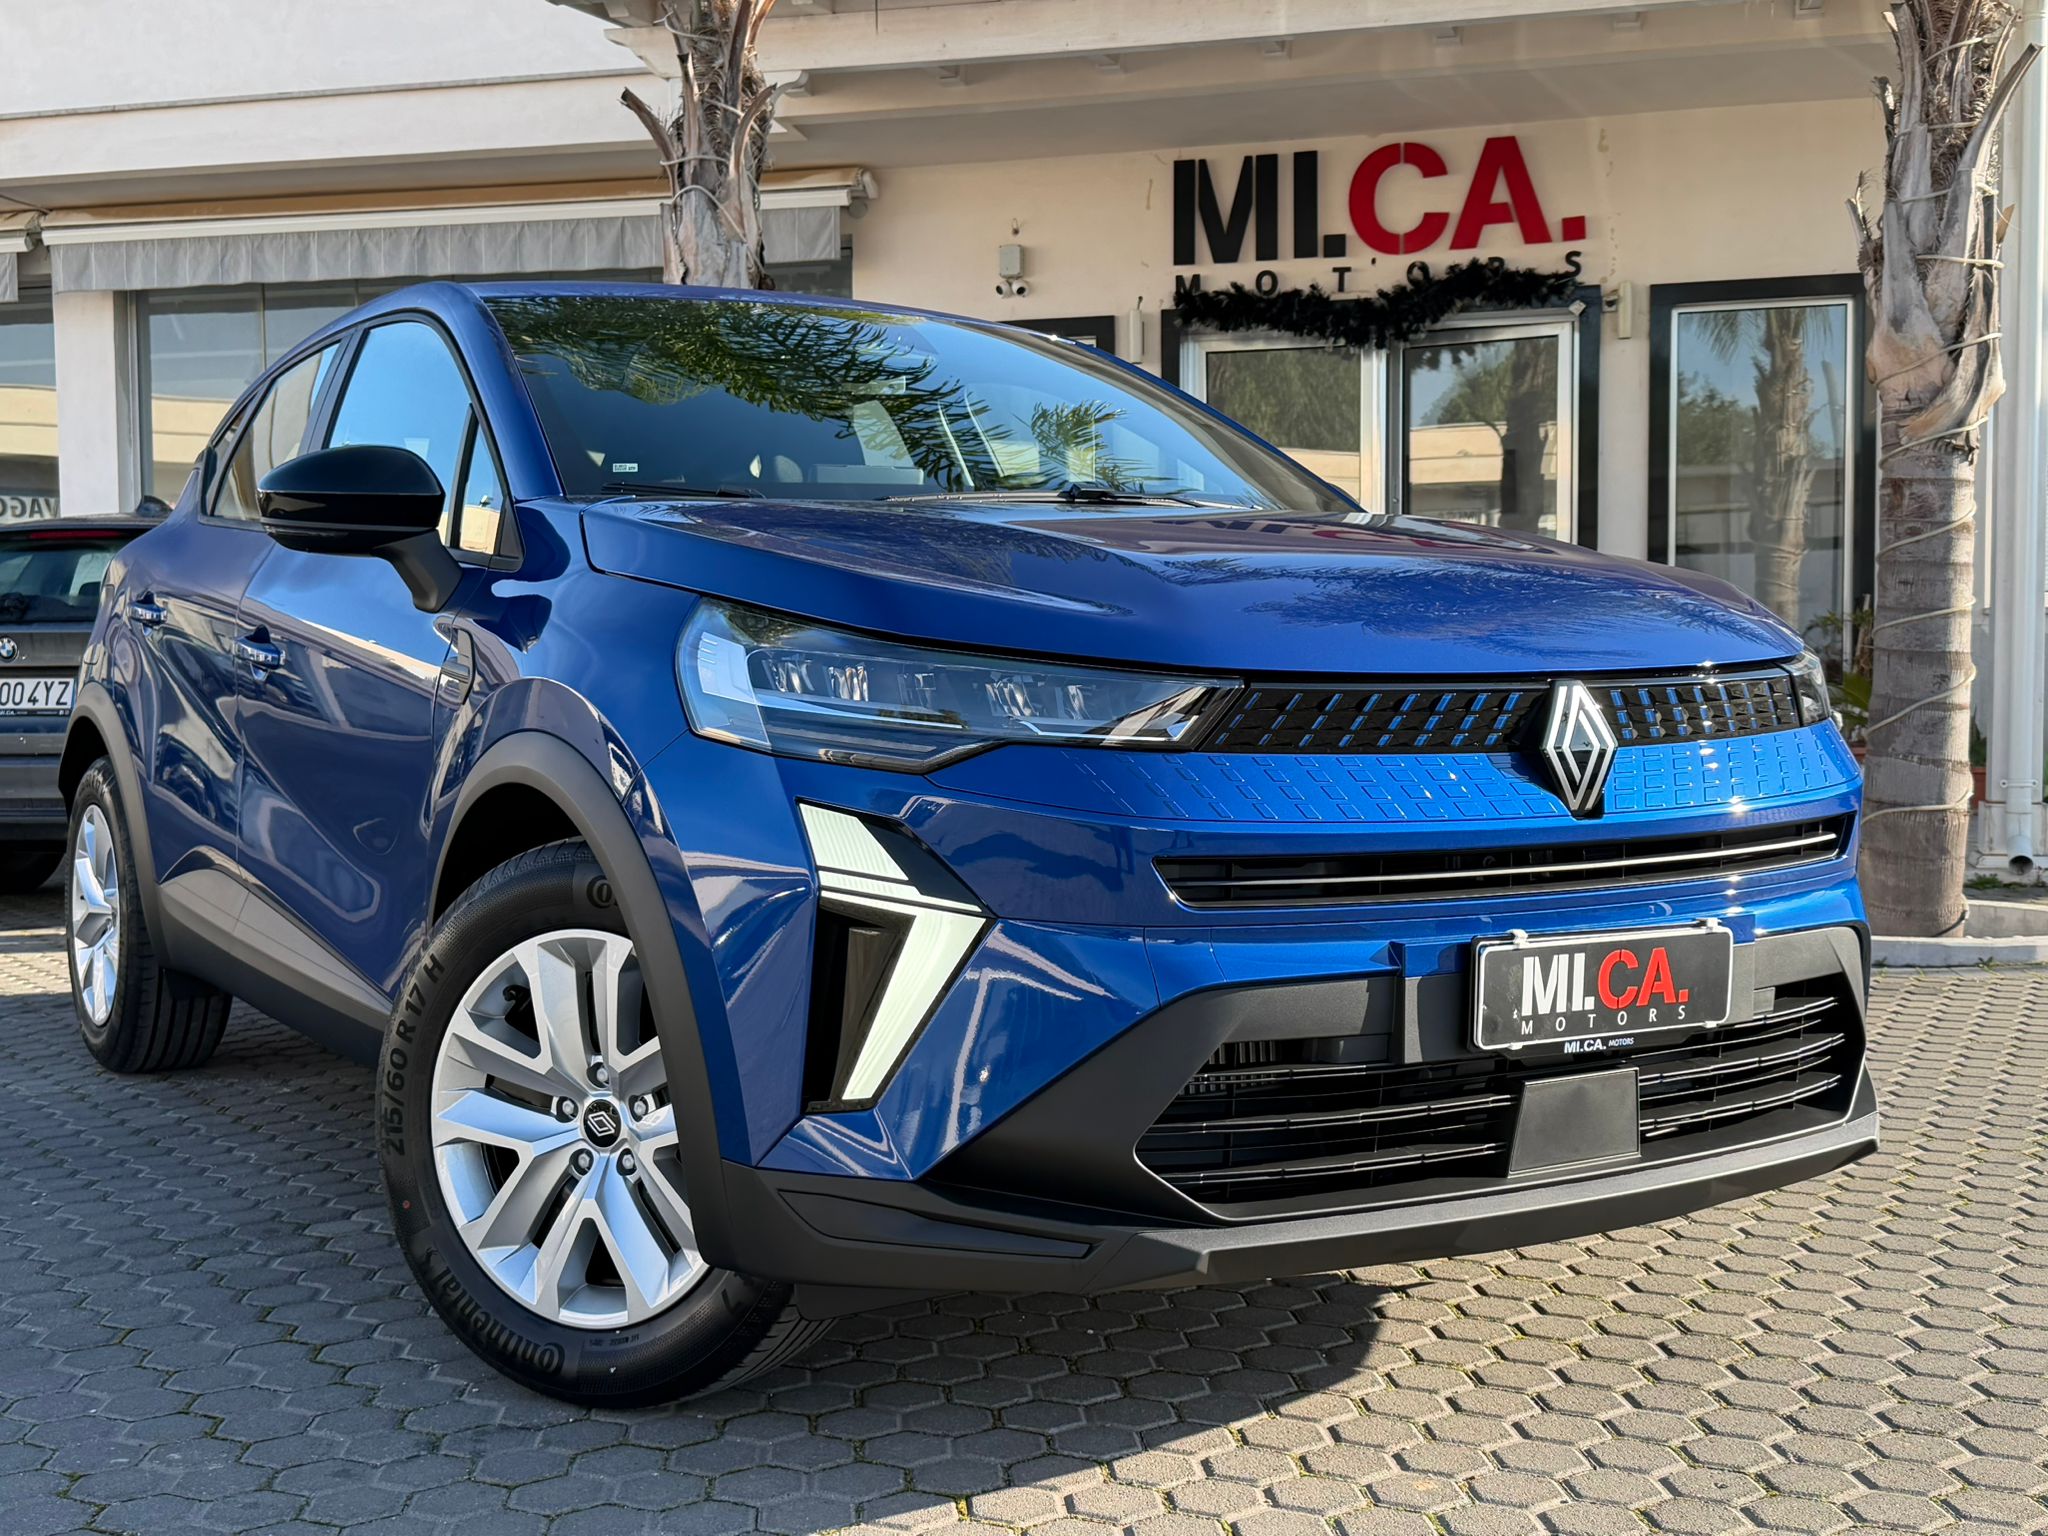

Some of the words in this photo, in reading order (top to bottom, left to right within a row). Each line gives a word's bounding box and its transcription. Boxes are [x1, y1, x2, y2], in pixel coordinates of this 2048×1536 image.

[1173, 136, 1586, 265] MI.CA.
[1521, 947, 1689, 1016] MI.CA.
[1521, 1005, 1686, 1035] MOTORS
[1608, 1037, 1635, 1047] MOTORS
[382, 1048, 408, 1157] 215/60
[423, 953, 446, 984] H
